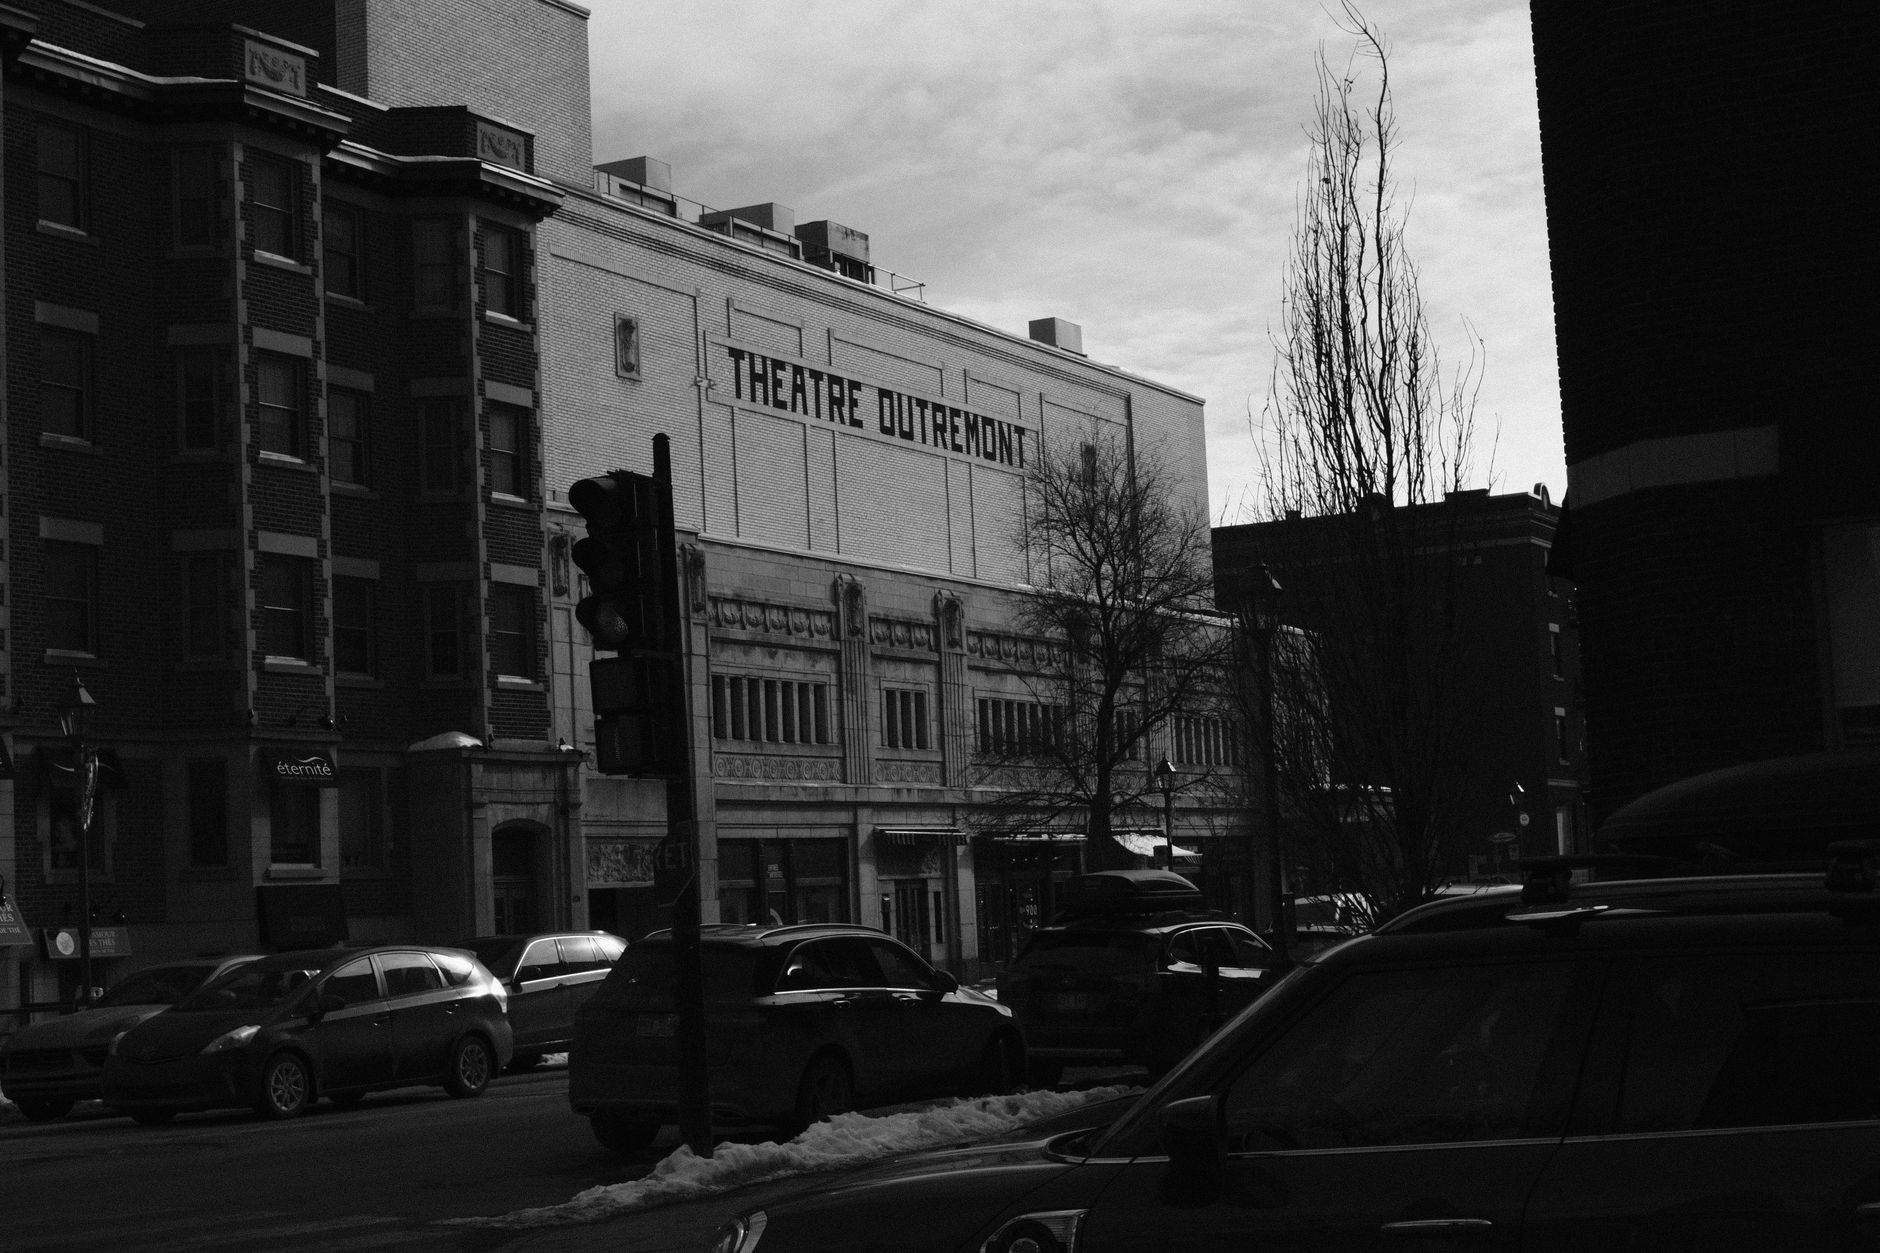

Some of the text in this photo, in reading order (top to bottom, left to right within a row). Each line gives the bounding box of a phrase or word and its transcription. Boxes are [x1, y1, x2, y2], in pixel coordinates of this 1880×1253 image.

[727, 346, 1027, 470] THEATRE OUTREMONT
[276, 760, 332, 776] éternité
